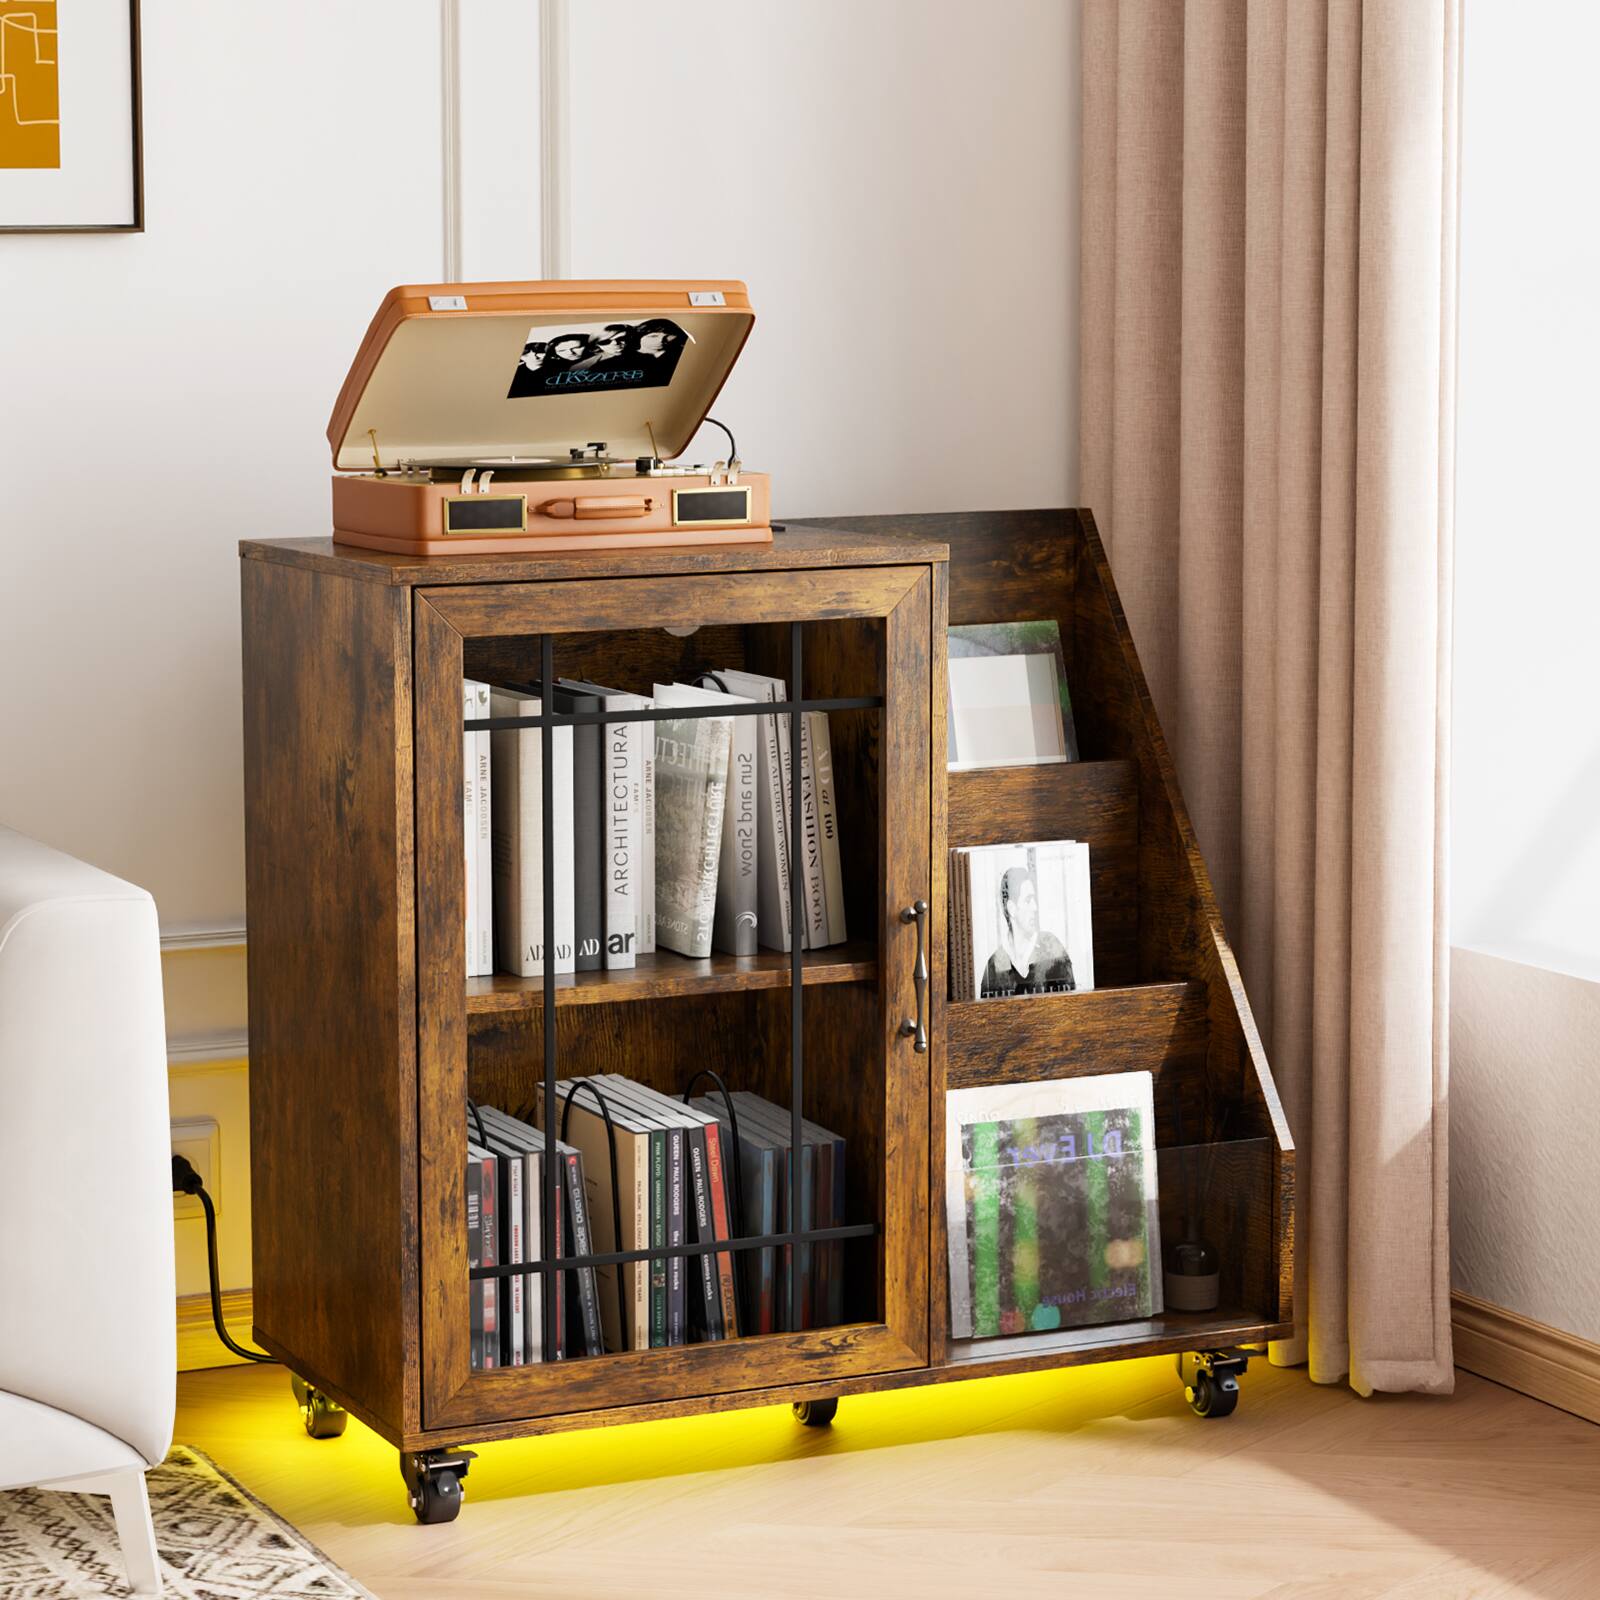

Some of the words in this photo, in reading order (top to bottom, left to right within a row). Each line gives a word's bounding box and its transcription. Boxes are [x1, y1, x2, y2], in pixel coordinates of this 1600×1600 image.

[769, 740, 777, 758] THE
[800, 721, 809, 769] THE
[480, 754, 488, 782] ARNE
[817, 745, 830, 784] AD
[771, 766, 783, 817] ALLURE
[822, 789, 830, 805] at
[613, 725, 628, 895] ARCHITECTURA
[802, 775, 818, 867] FASHION
[776, 820, 784, 834] OF
[824, 813, 834, 839] 100
[778, 840, 789, 890] WOMEN
[810, 876, 823, 931] BOOK
[579, 938, 600, 957] AD
[608, 932, 635, 954] ar
[709, 1137, 717, 1159] Steel
[711, 1160, 720, 1183] Dawn
[692, 1147, 701, 1172] QUEEN
[698, 1195, 706, 1228] RODGERS
